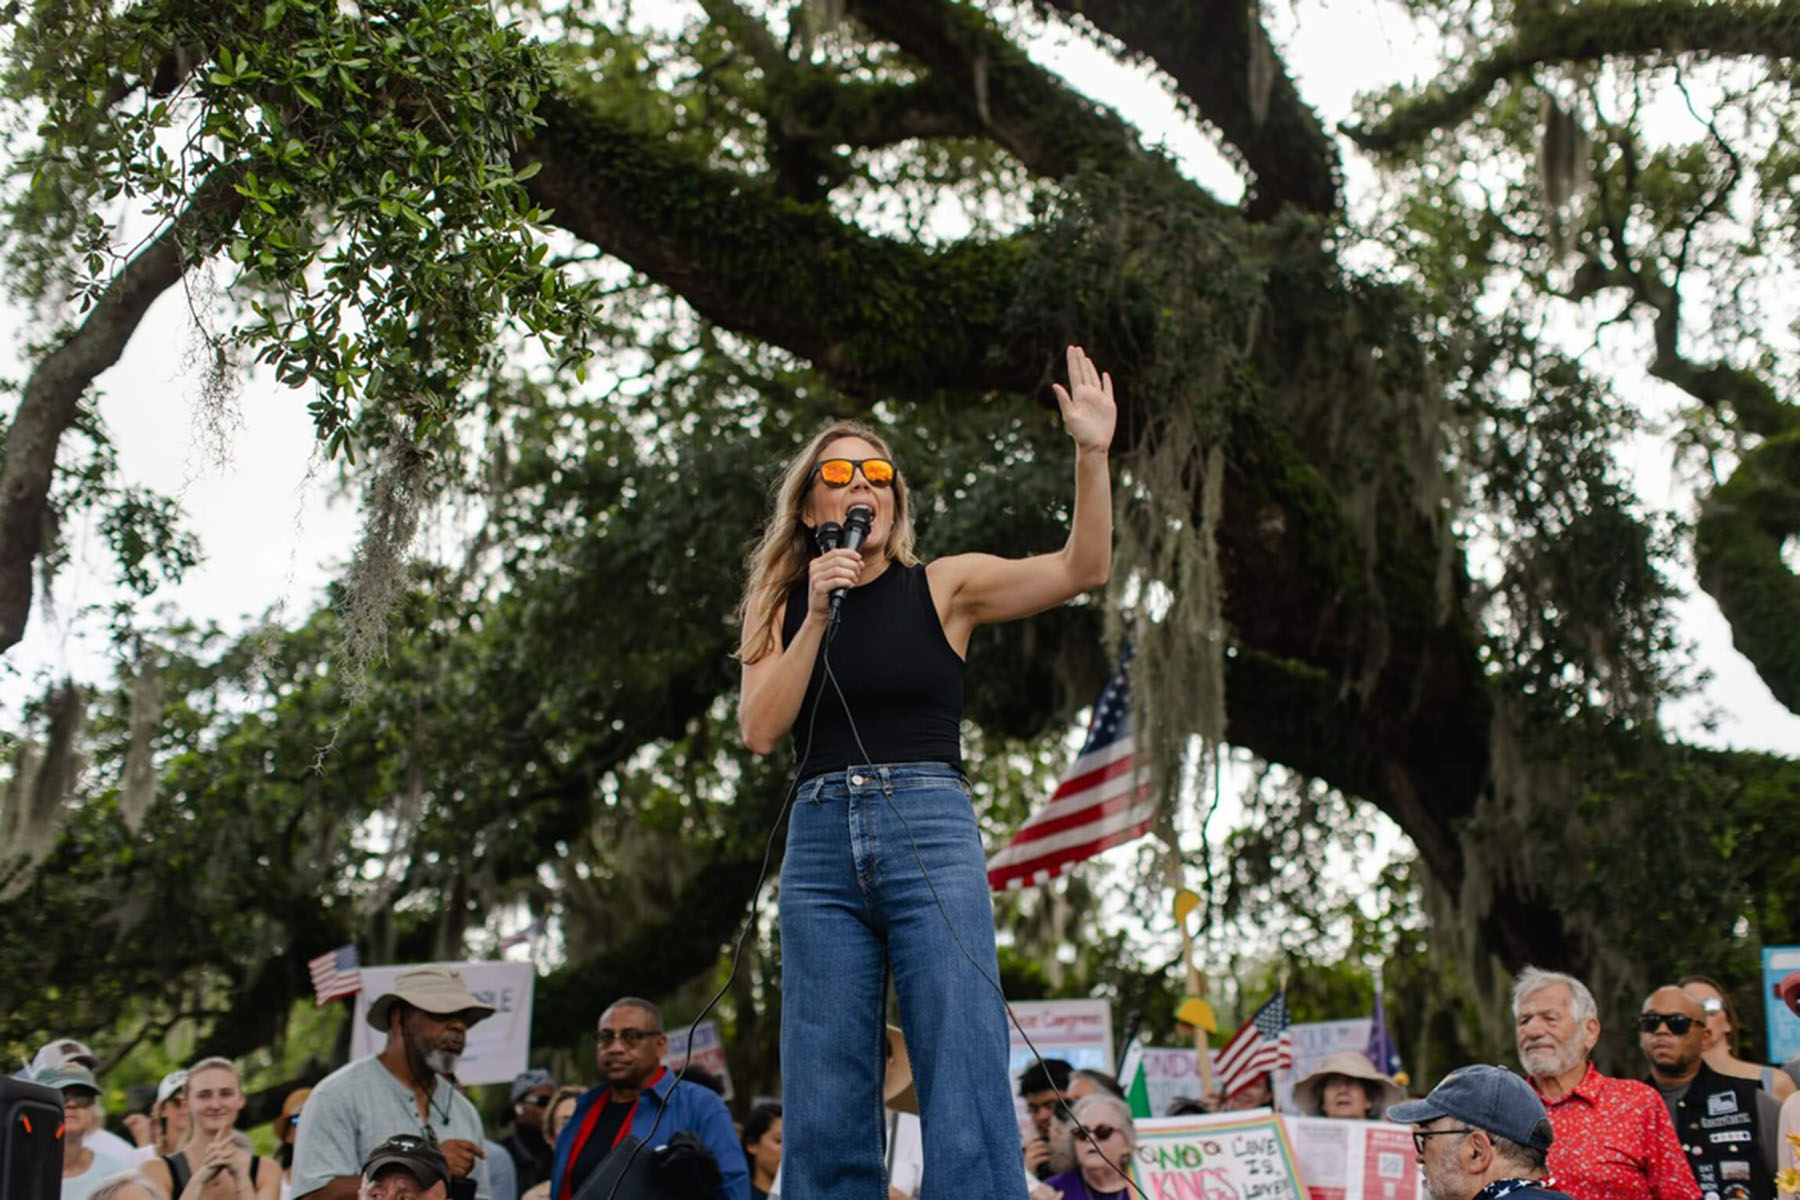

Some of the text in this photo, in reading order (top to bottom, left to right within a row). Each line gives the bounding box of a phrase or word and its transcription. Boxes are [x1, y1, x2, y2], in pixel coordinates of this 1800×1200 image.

[1159, 1144, 1202, 1170] NO
[1231, 1138, 1277, 1157] LOVE
[1148, 1167, 1239, 1200] KINGS
